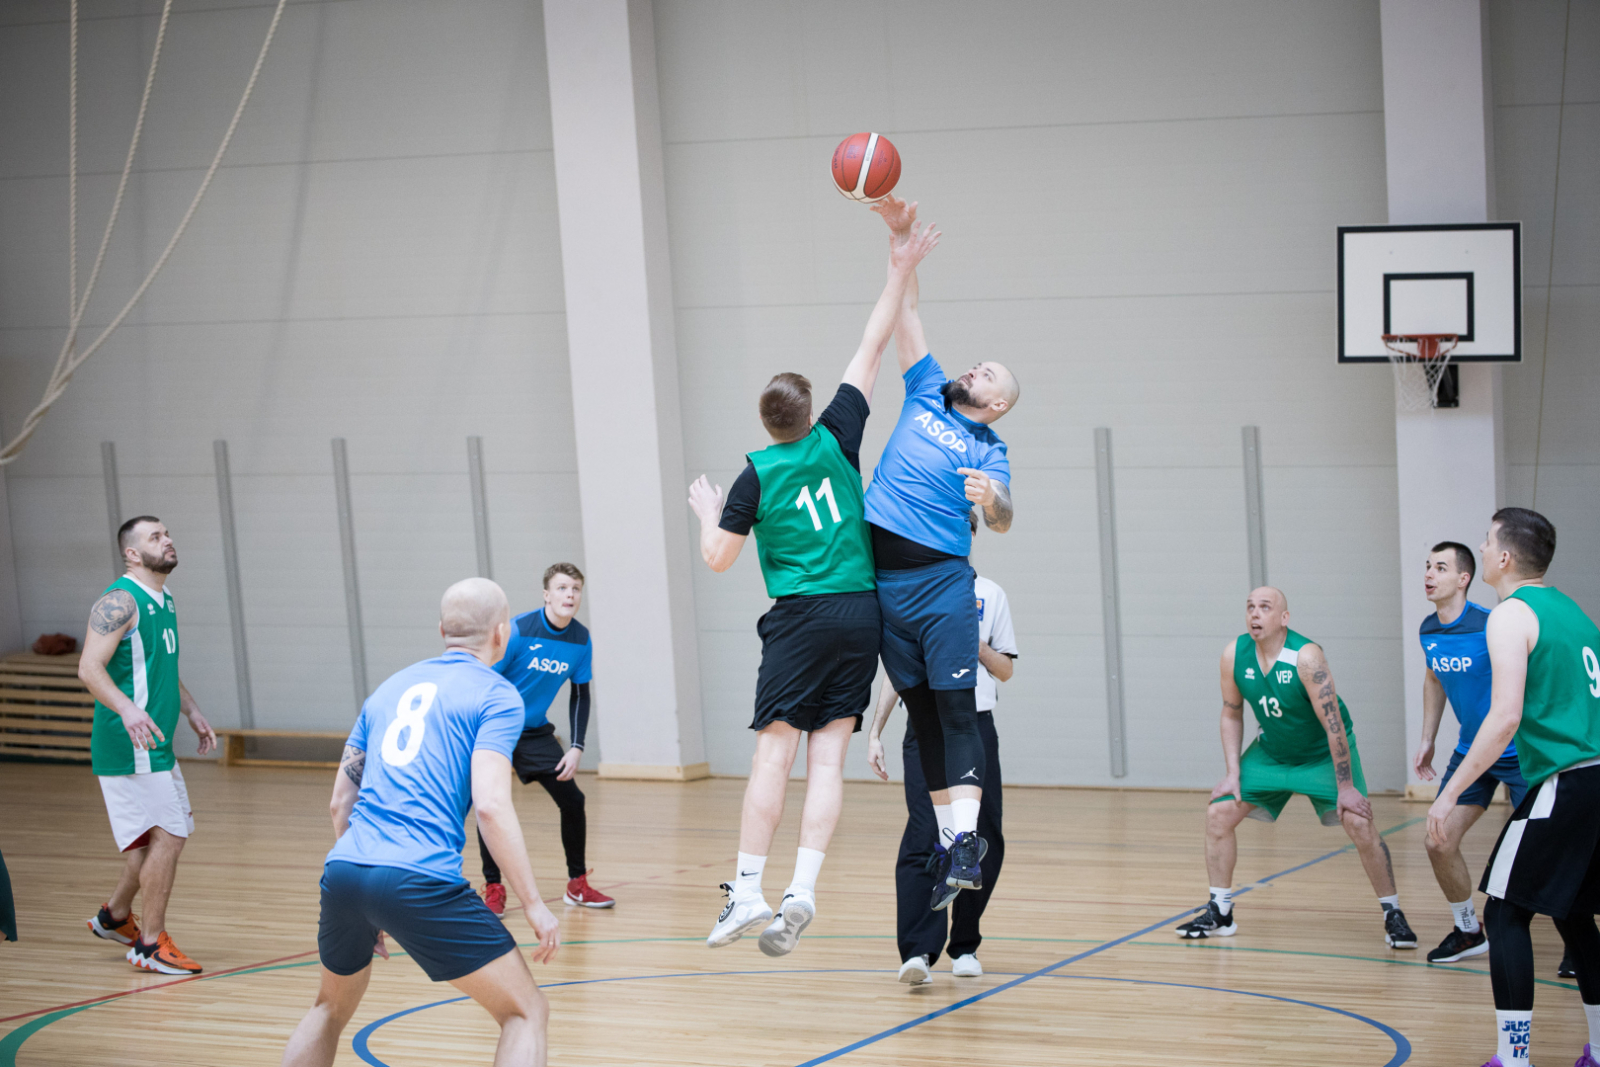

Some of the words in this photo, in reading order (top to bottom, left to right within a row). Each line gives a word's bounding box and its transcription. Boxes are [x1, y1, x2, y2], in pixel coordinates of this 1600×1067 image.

[914, 411, 967, 453] ASOP
[795, 476, 842, 532] 11
[162, 628, 176, 655] 10
[527, 656, 569, 676] ASOP
[1432, 656, 1473, 673] ASOP
[1582, 645, 1600, 699] 9
[1275, 669, 1293, 685] VEP
[1258, 695, 1283, 718] 13
[381, 682, 438, 767] 8
[1502, 1020, 1531, 1032] JUS
[1509, 1032, 1530, 1045] DO
